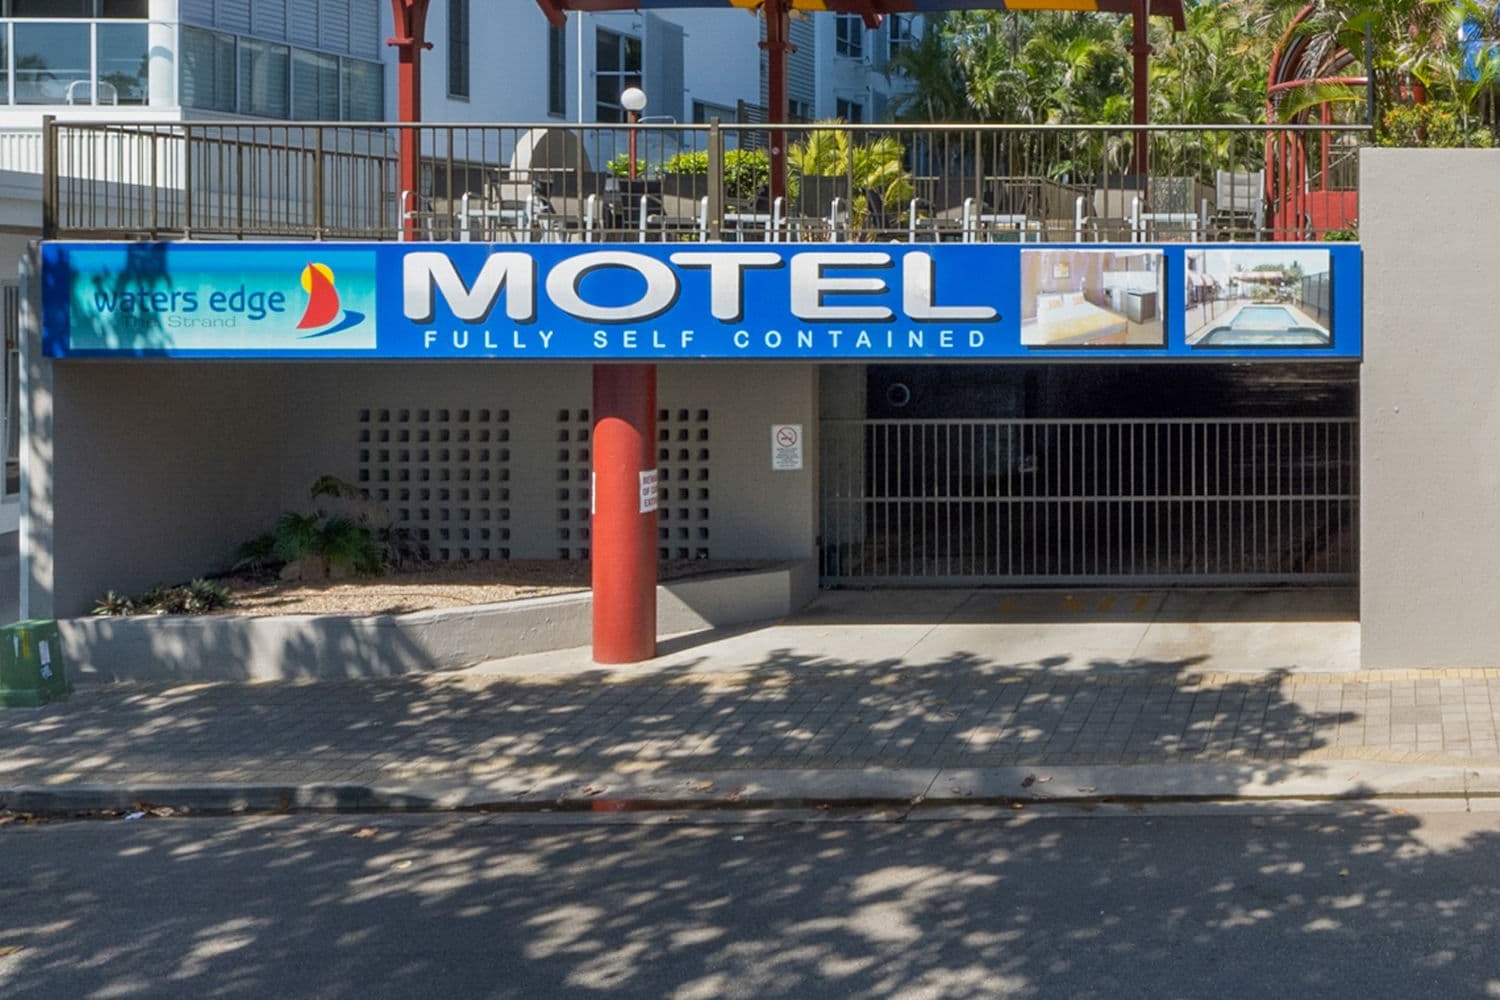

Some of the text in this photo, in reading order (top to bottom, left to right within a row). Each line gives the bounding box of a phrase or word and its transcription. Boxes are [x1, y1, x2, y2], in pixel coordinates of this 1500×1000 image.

[402, 250, 998, 322] MOTEL
[93, 284, 286, 321] waters edge
[167, 315, 237, 329] Strand
[423, 329, 985, 349] FULLY SELF CONTAINED
